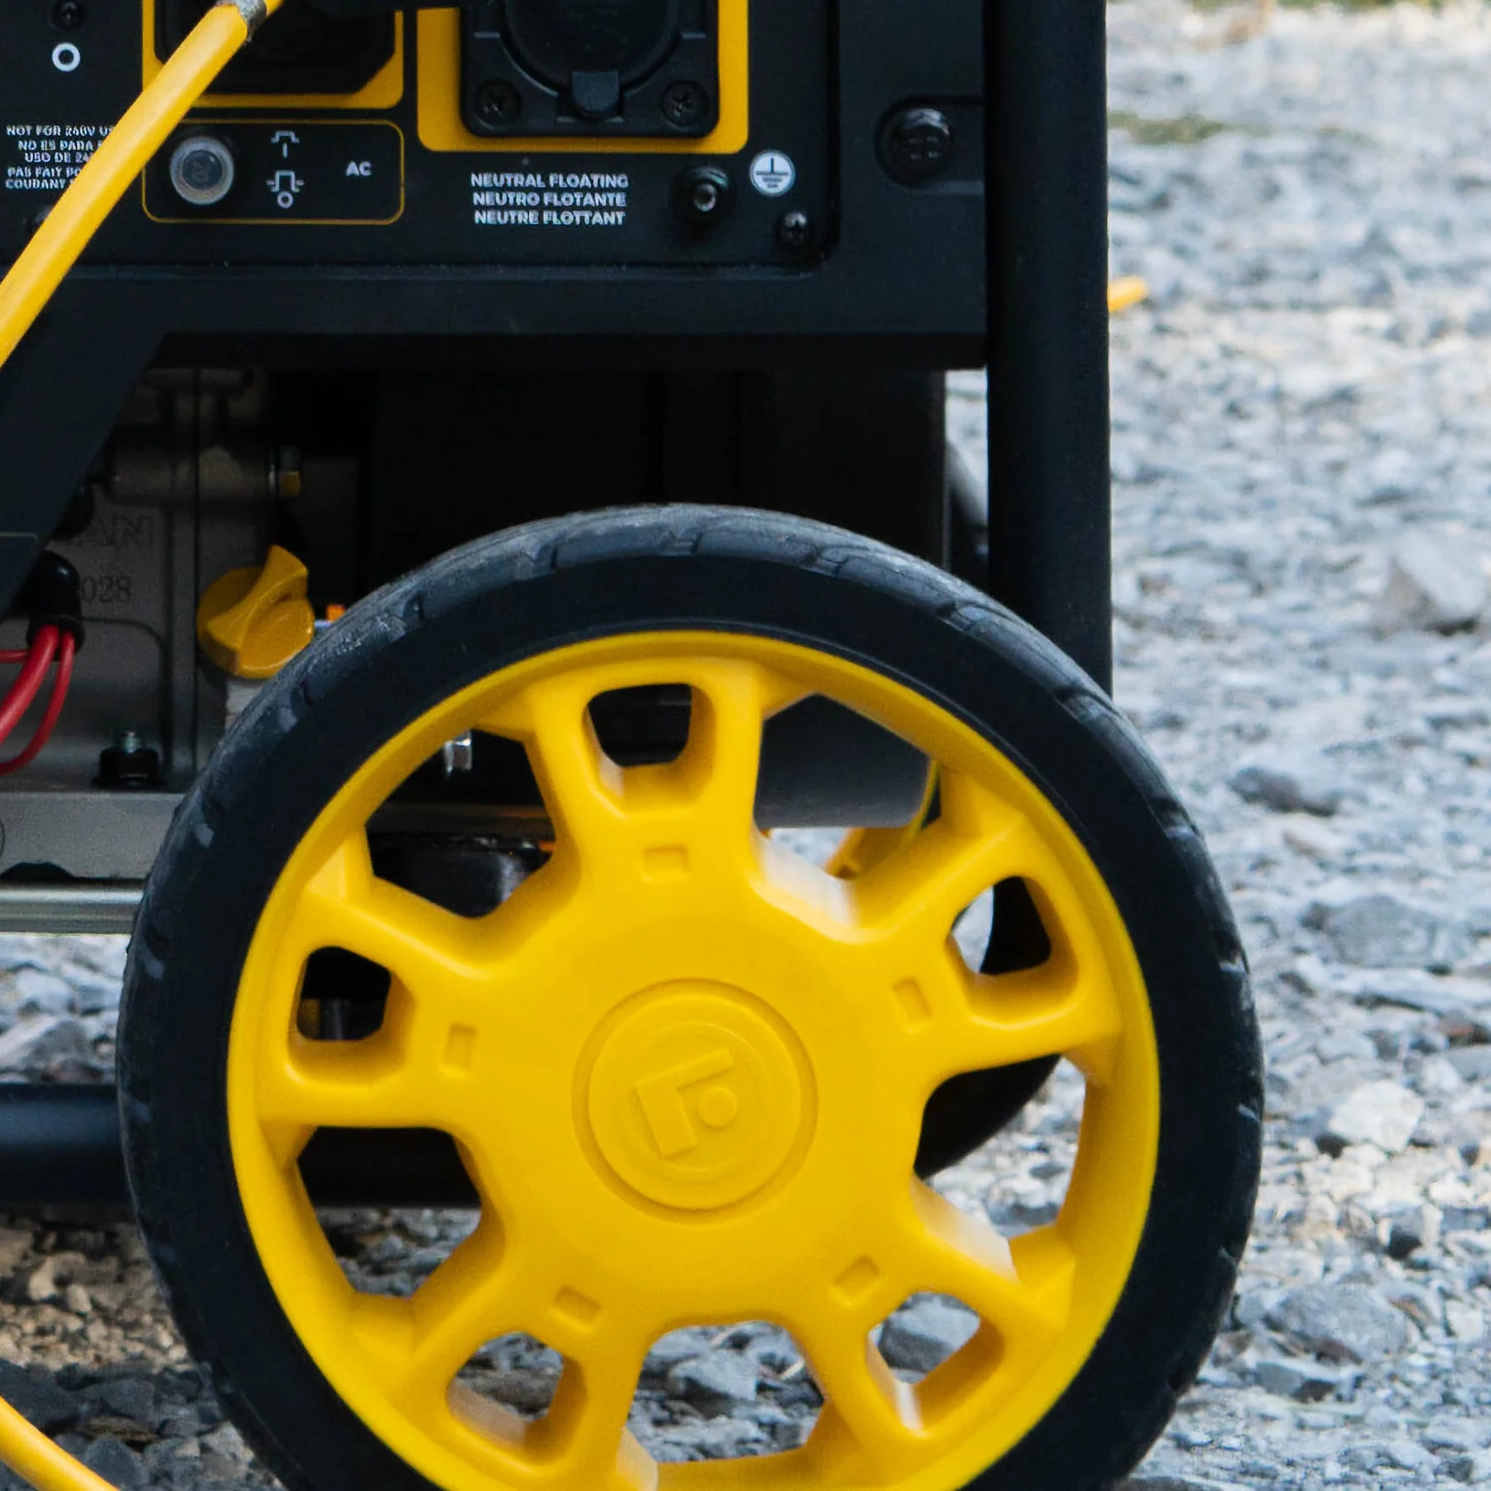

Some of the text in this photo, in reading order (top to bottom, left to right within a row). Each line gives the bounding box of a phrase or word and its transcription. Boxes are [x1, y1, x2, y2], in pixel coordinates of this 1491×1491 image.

[346, 162, 371, 176] AC
[471, 174, 628, 188] NEUTRAL FLOATING
[473, 192, 625, 206] NEUTRO FLOTANTE
[475, 210, 625, 225] NEUTRE FLOTTANT
